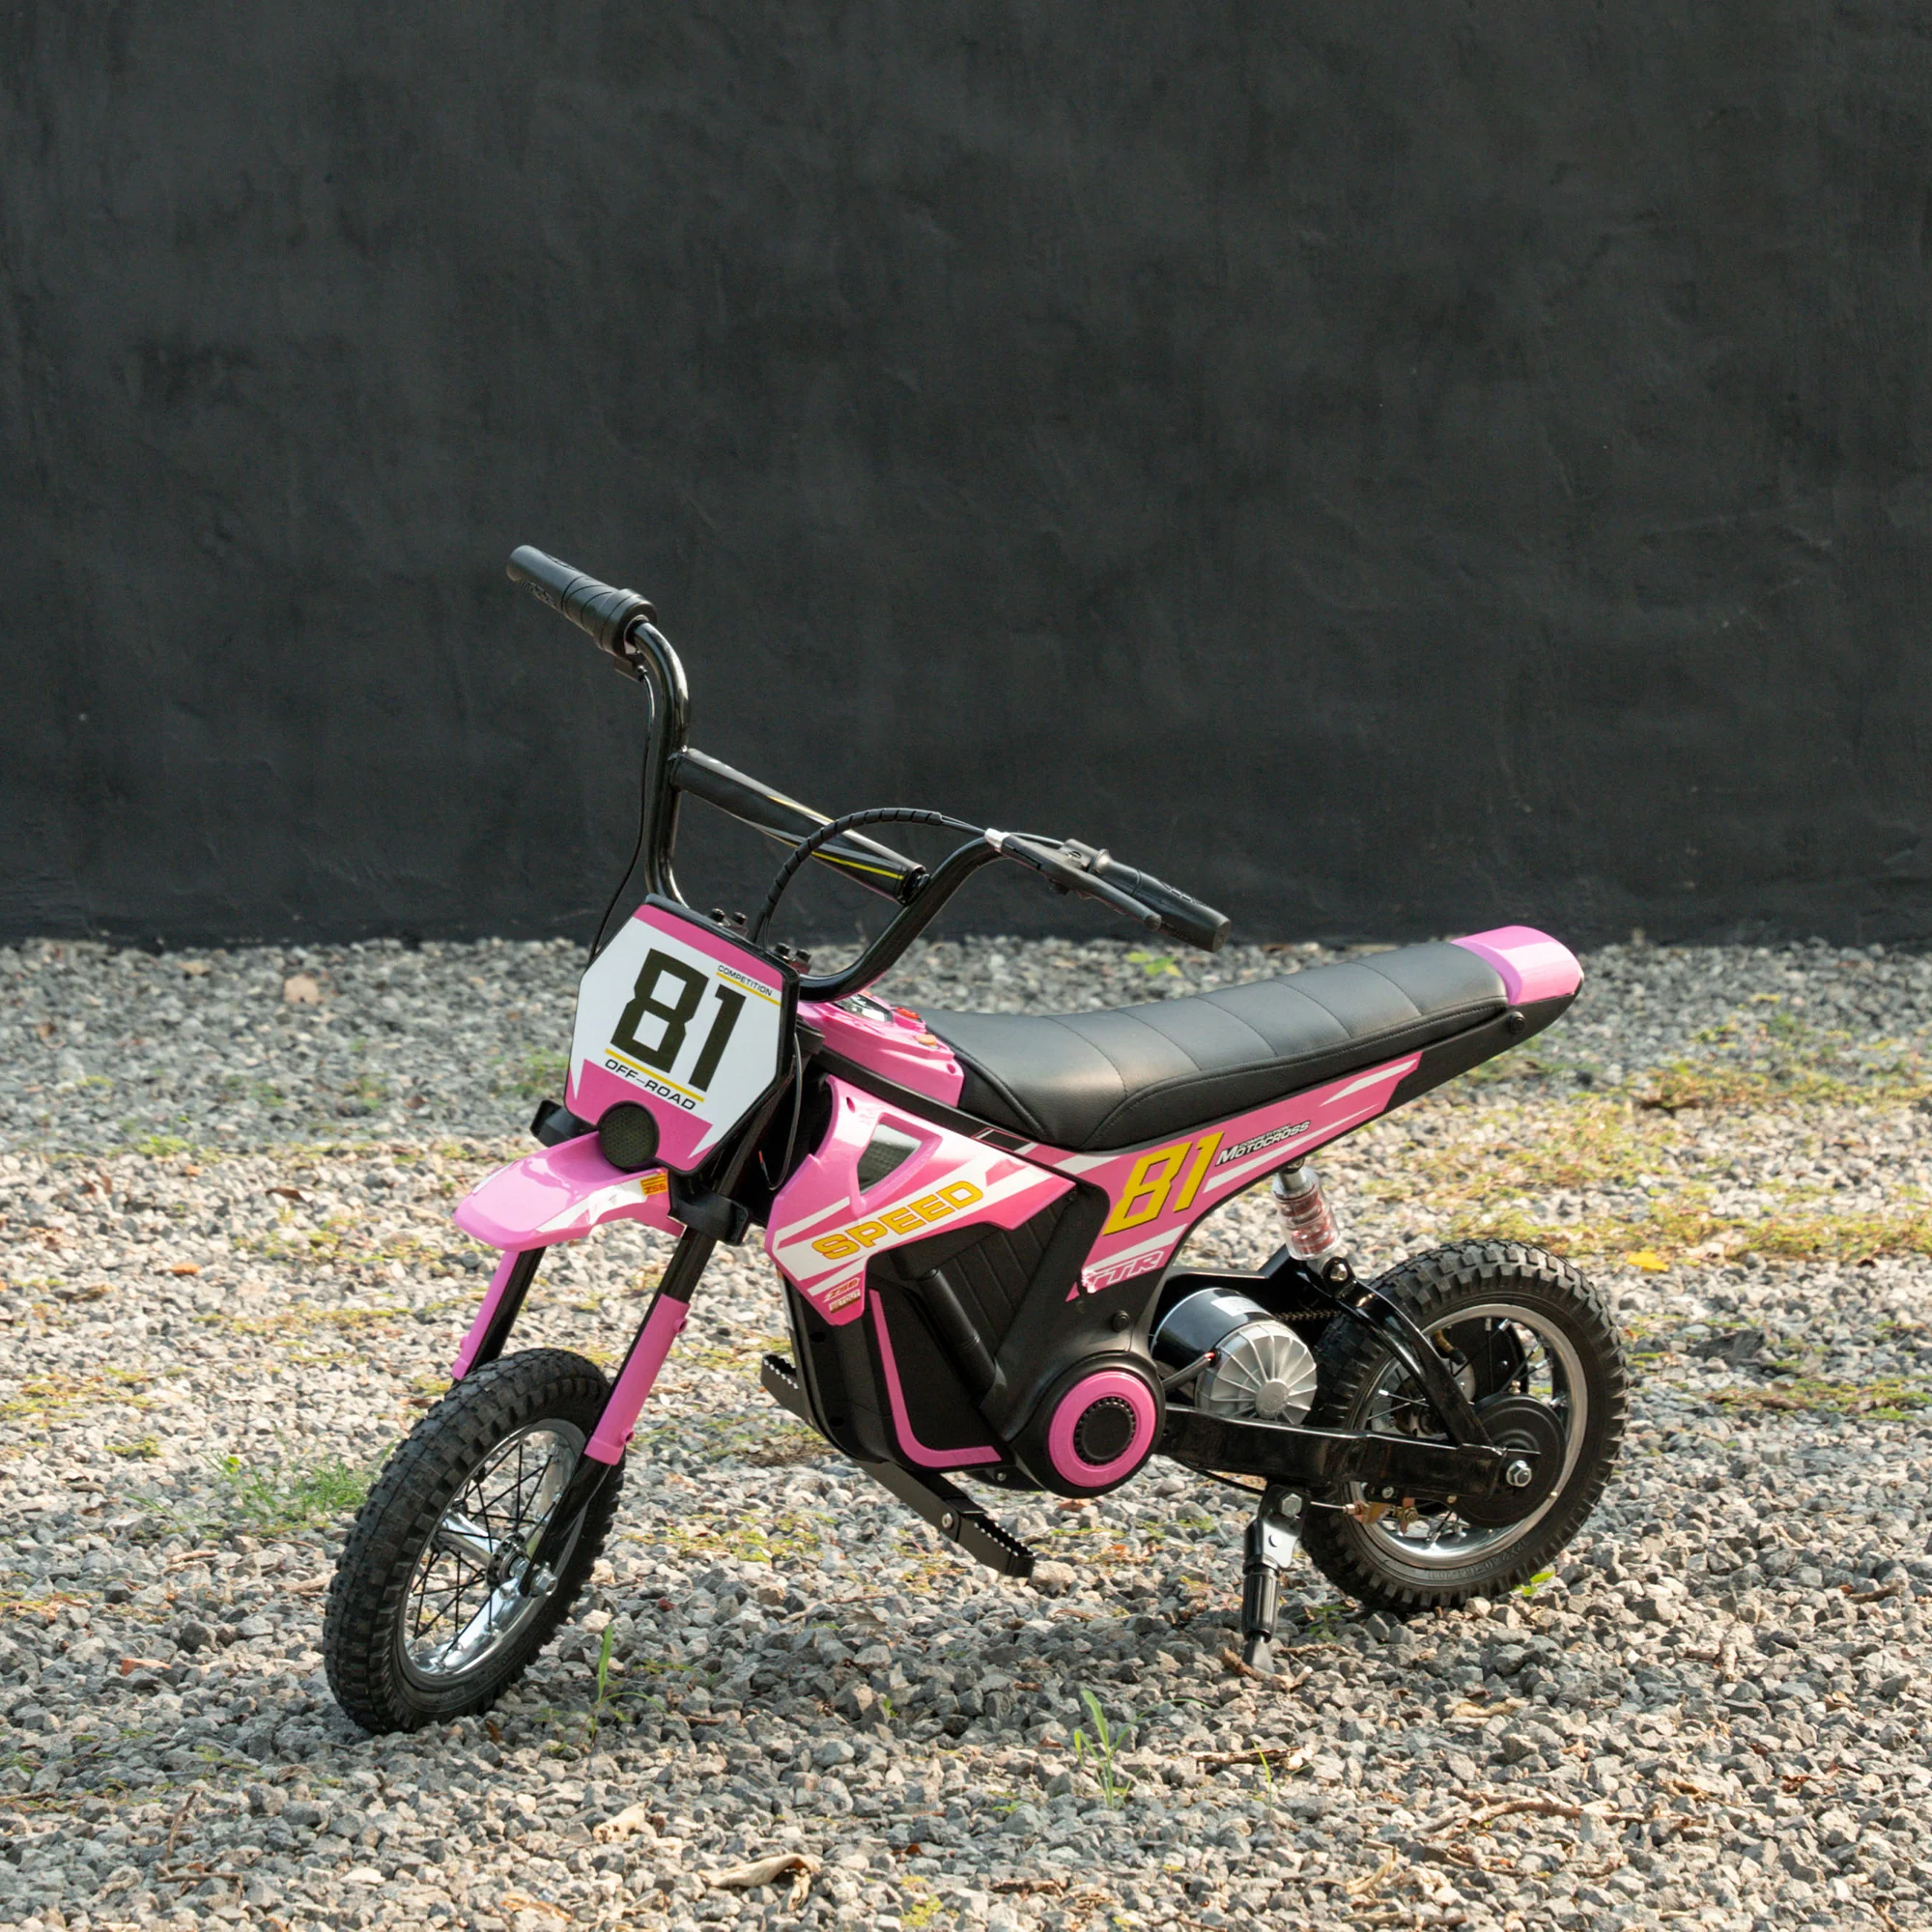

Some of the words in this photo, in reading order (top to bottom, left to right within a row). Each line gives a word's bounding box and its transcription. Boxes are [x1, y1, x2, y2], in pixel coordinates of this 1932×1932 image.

[718, 964, 774, 997] COMPETITION
[610, 947, 748, 1094] 81
[604, 1058, 697, 1111] OFF-ROAD
[1214, 1120, 1311, 1167] MOTOCROSS
[1102, 1130, 1225, 1236] 81
[810, 1179, 984, 1260] SPEED
